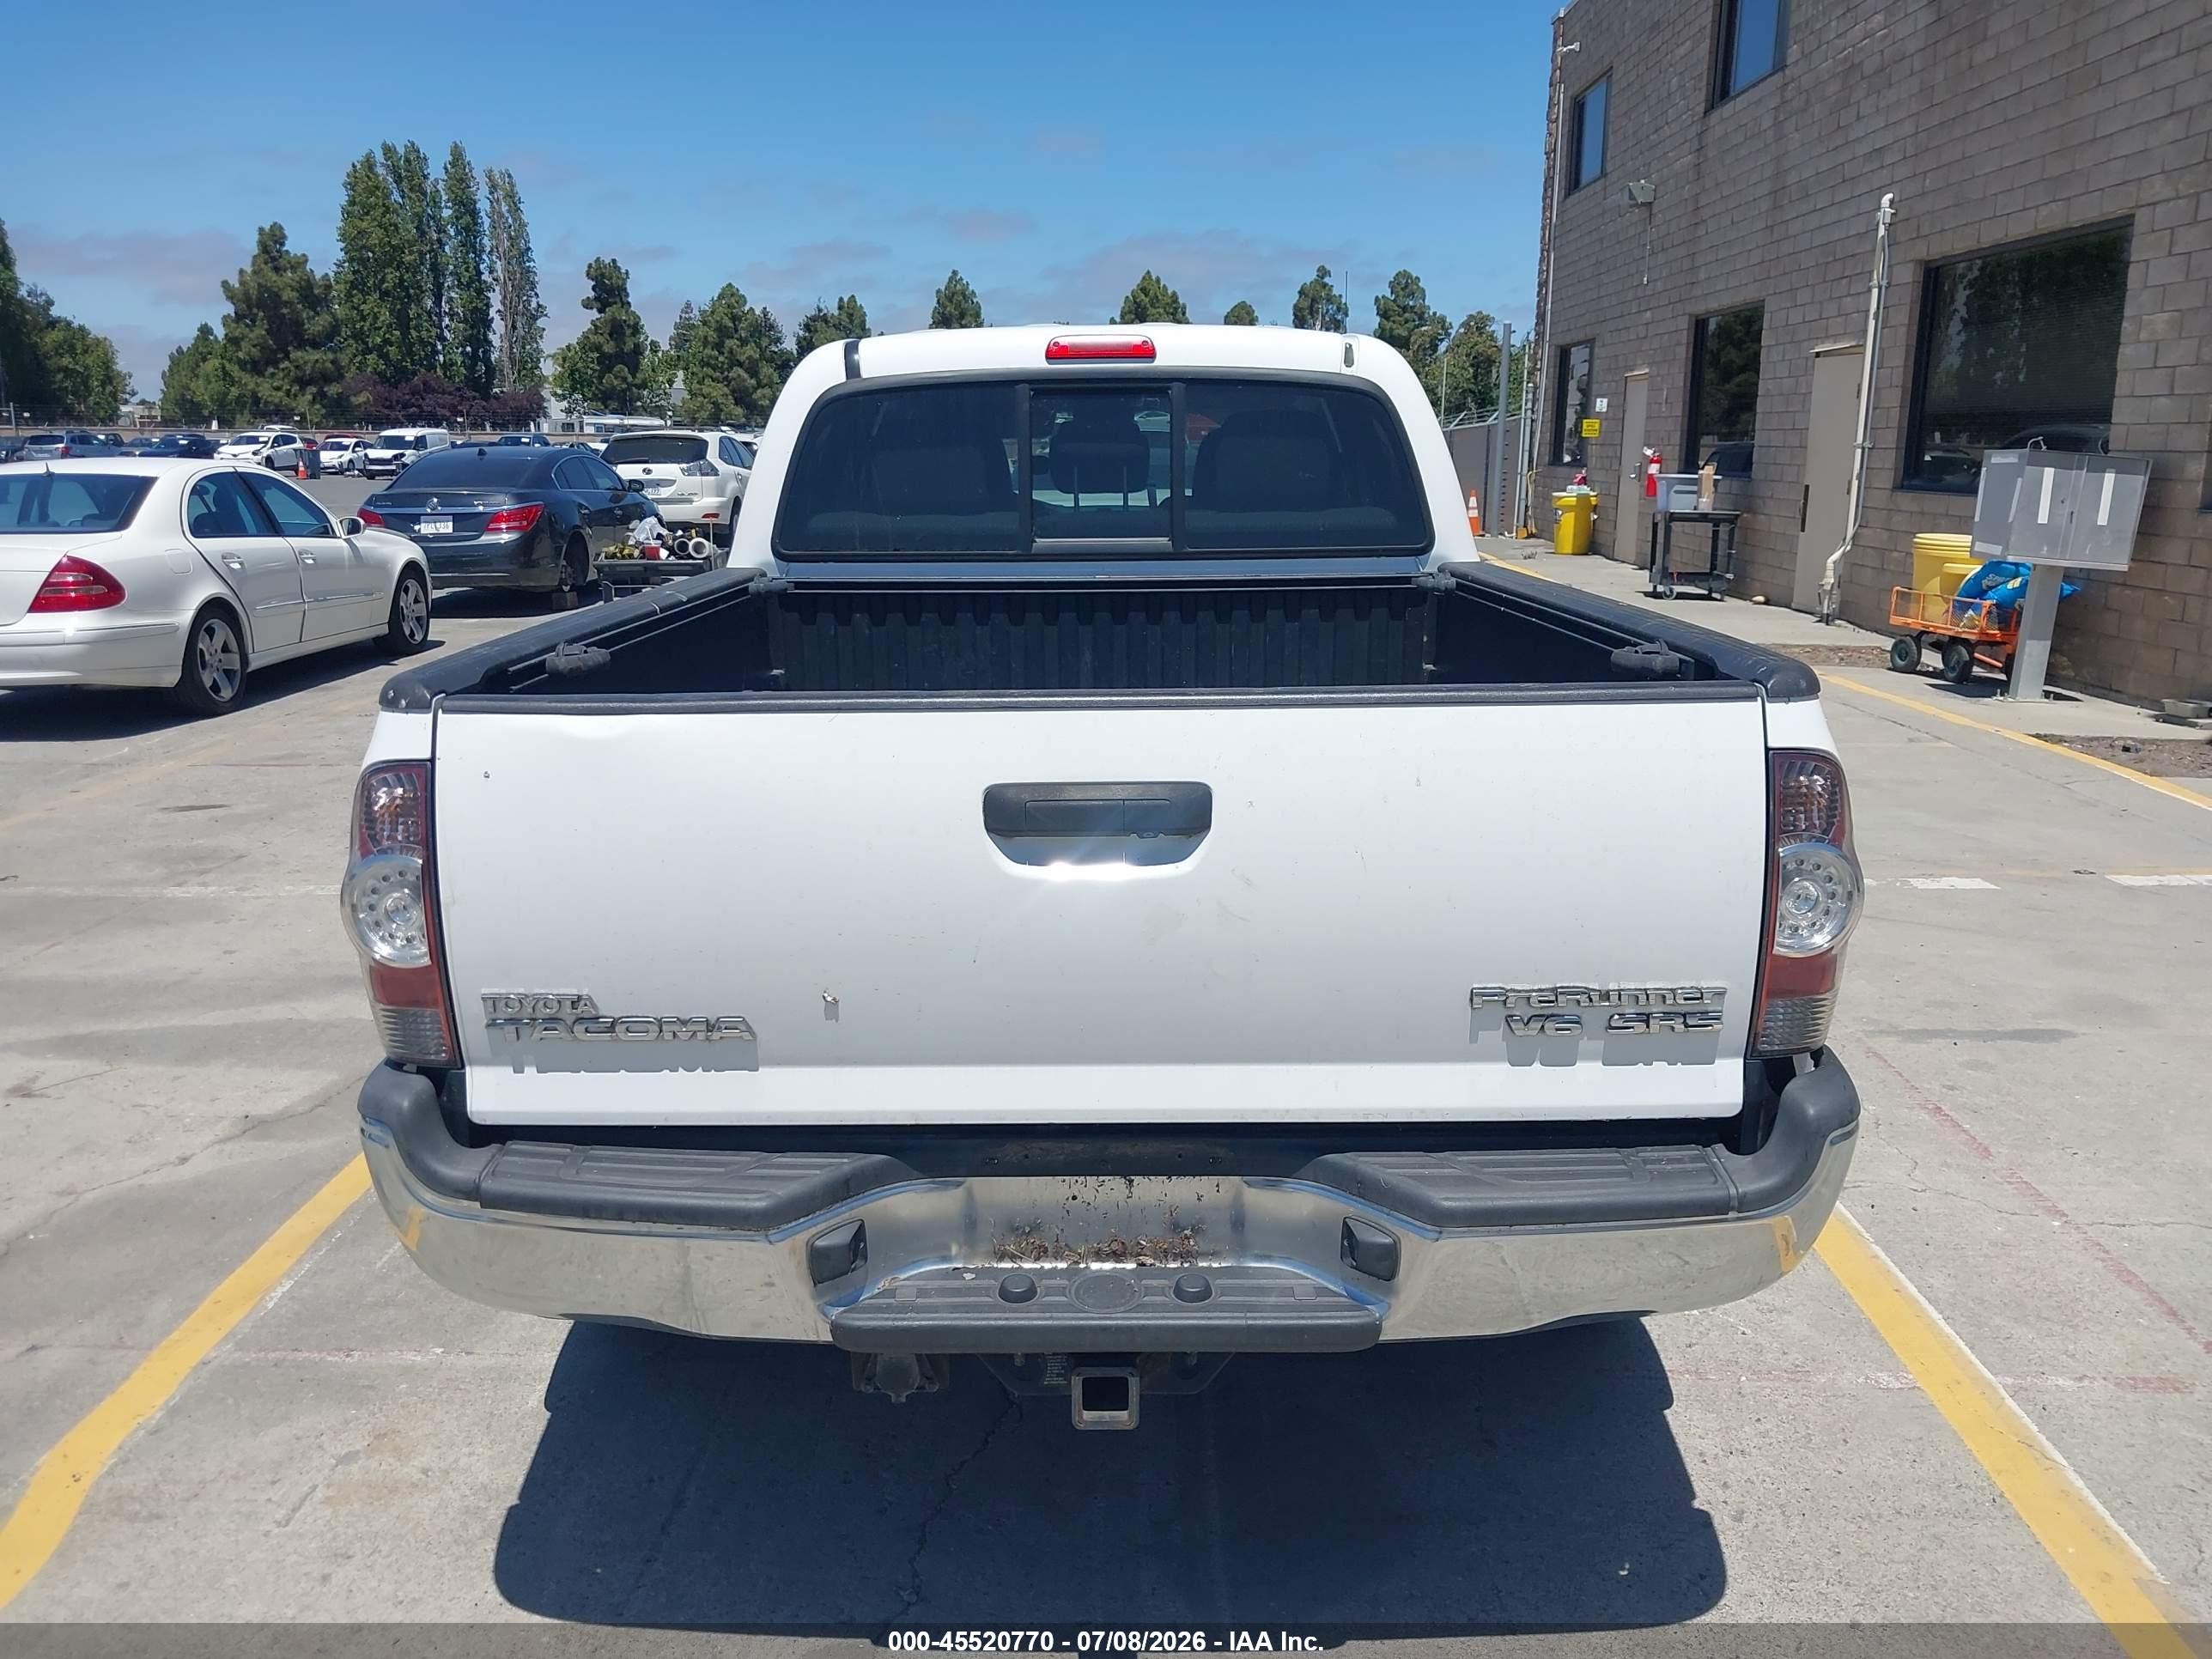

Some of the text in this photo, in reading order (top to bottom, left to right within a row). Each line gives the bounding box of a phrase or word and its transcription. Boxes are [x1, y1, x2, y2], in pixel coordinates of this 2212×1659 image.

[482, 993, 598, 1015] TOYOTA
[1470, 986, 1728, 1009] PreRunner
[485, 1017, 757, 1042] TACOMA
[1505, 1011, 1724, 1036] V6 SR5
